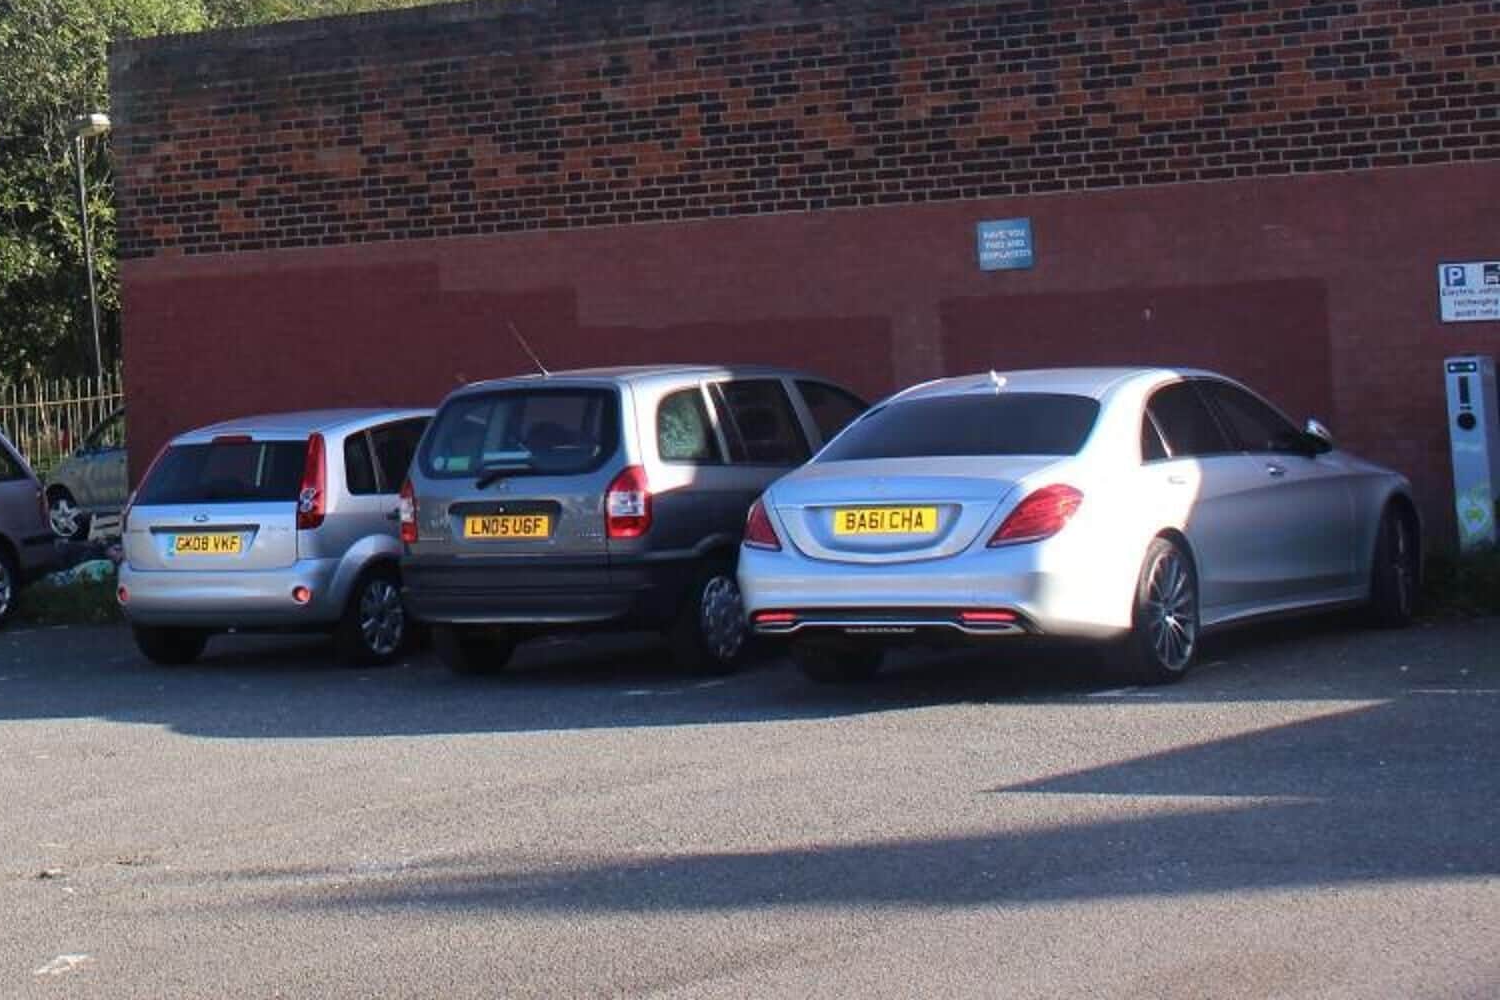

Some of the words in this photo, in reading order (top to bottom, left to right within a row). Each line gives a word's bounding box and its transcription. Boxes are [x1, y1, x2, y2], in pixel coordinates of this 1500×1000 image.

[1449, 267, 1462, 284] P
[471, 518, 510, 535] LN05
[845, 511, 885, 531] BA61
[889, 509, 924, 530] CHA
[212, 535, 239, 550] VKF
